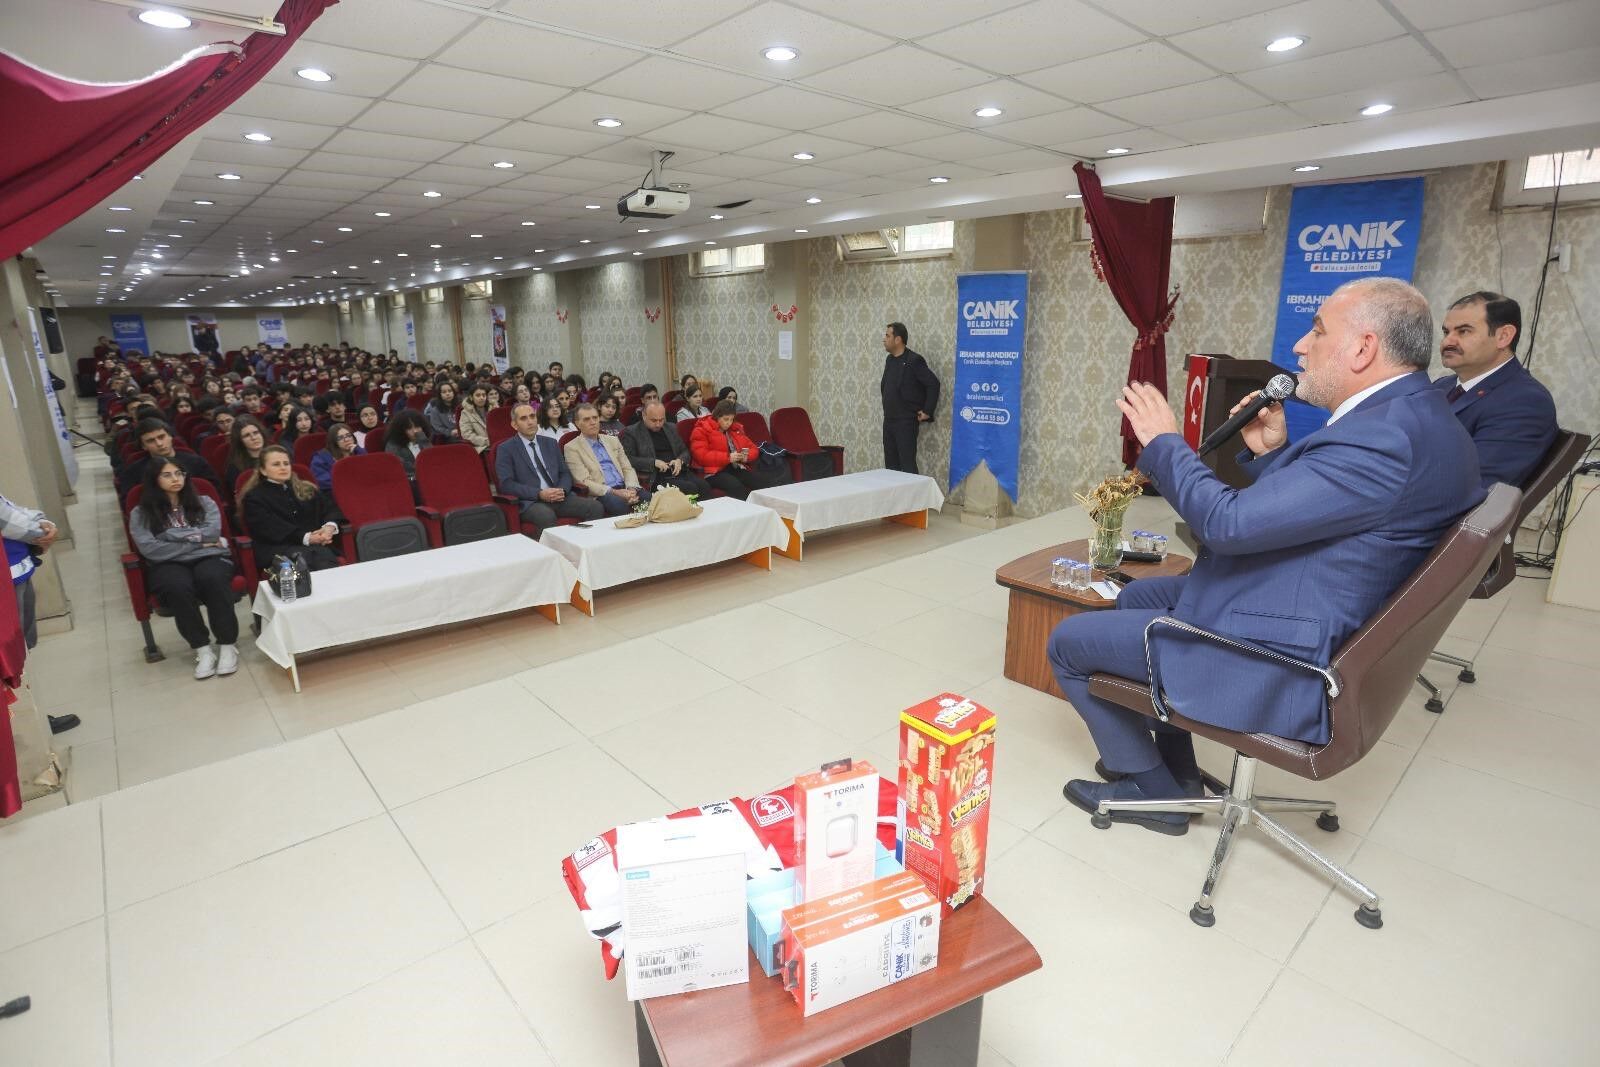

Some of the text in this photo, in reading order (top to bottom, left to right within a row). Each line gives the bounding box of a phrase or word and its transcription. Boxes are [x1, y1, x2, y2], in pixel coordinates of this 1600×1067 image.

[1304, 250, 1392, 262] BELEDİYESİ
[1295, 305, 1316, 313] Canik
[834, 783, 865, 796] TORIMA
